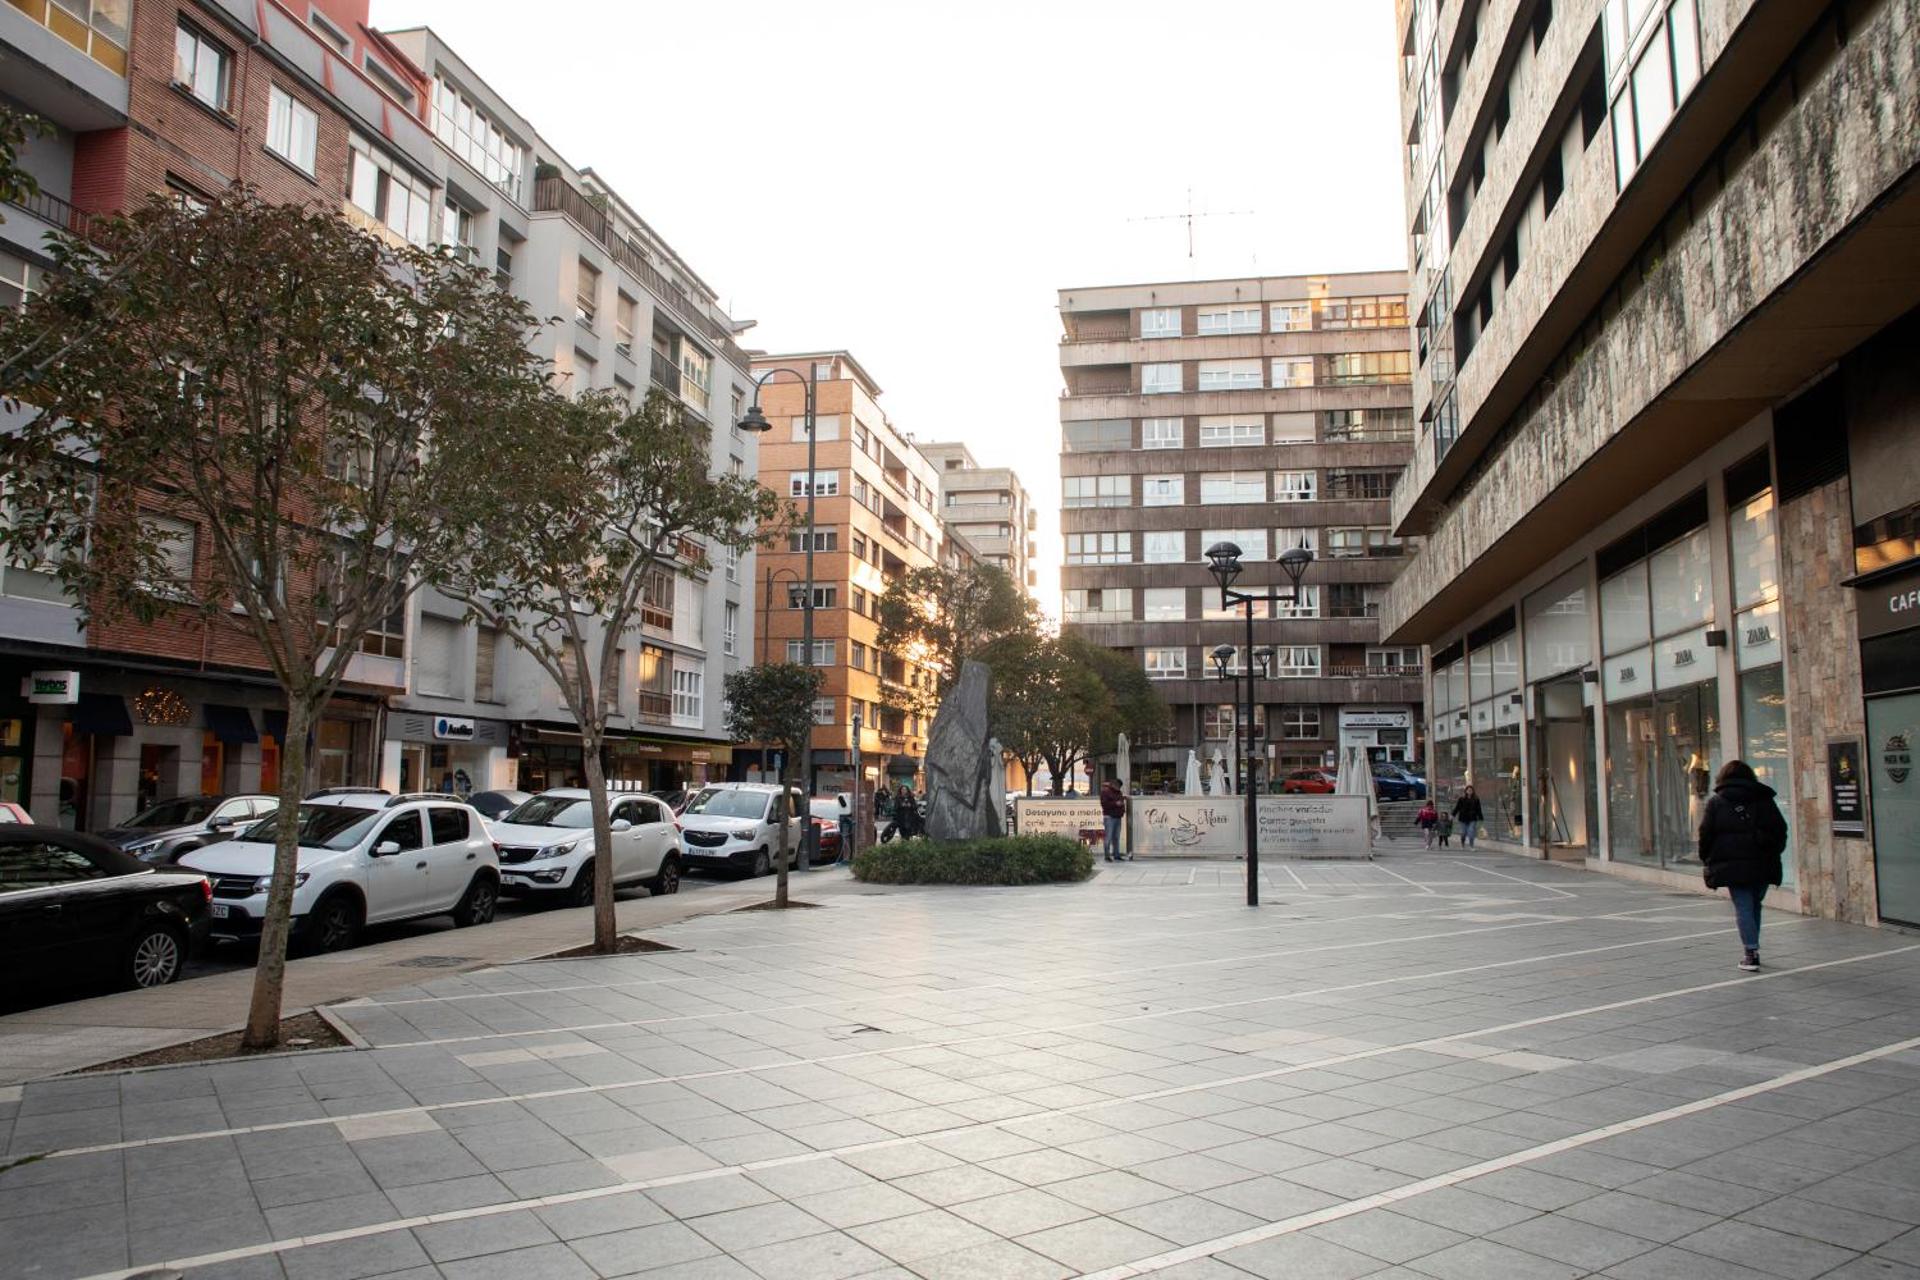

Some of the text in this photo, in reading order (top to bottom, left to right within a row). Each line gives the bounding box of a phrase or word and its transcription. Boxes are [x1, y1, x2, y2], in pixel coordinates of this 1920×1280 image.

[1890, 590, 1920, 612] CAF
[1747, 626, 1771, 644] ZARA
[1675, 649, 1694, 664] ZARA
[1620, 667, 1635, 680] ZARA
